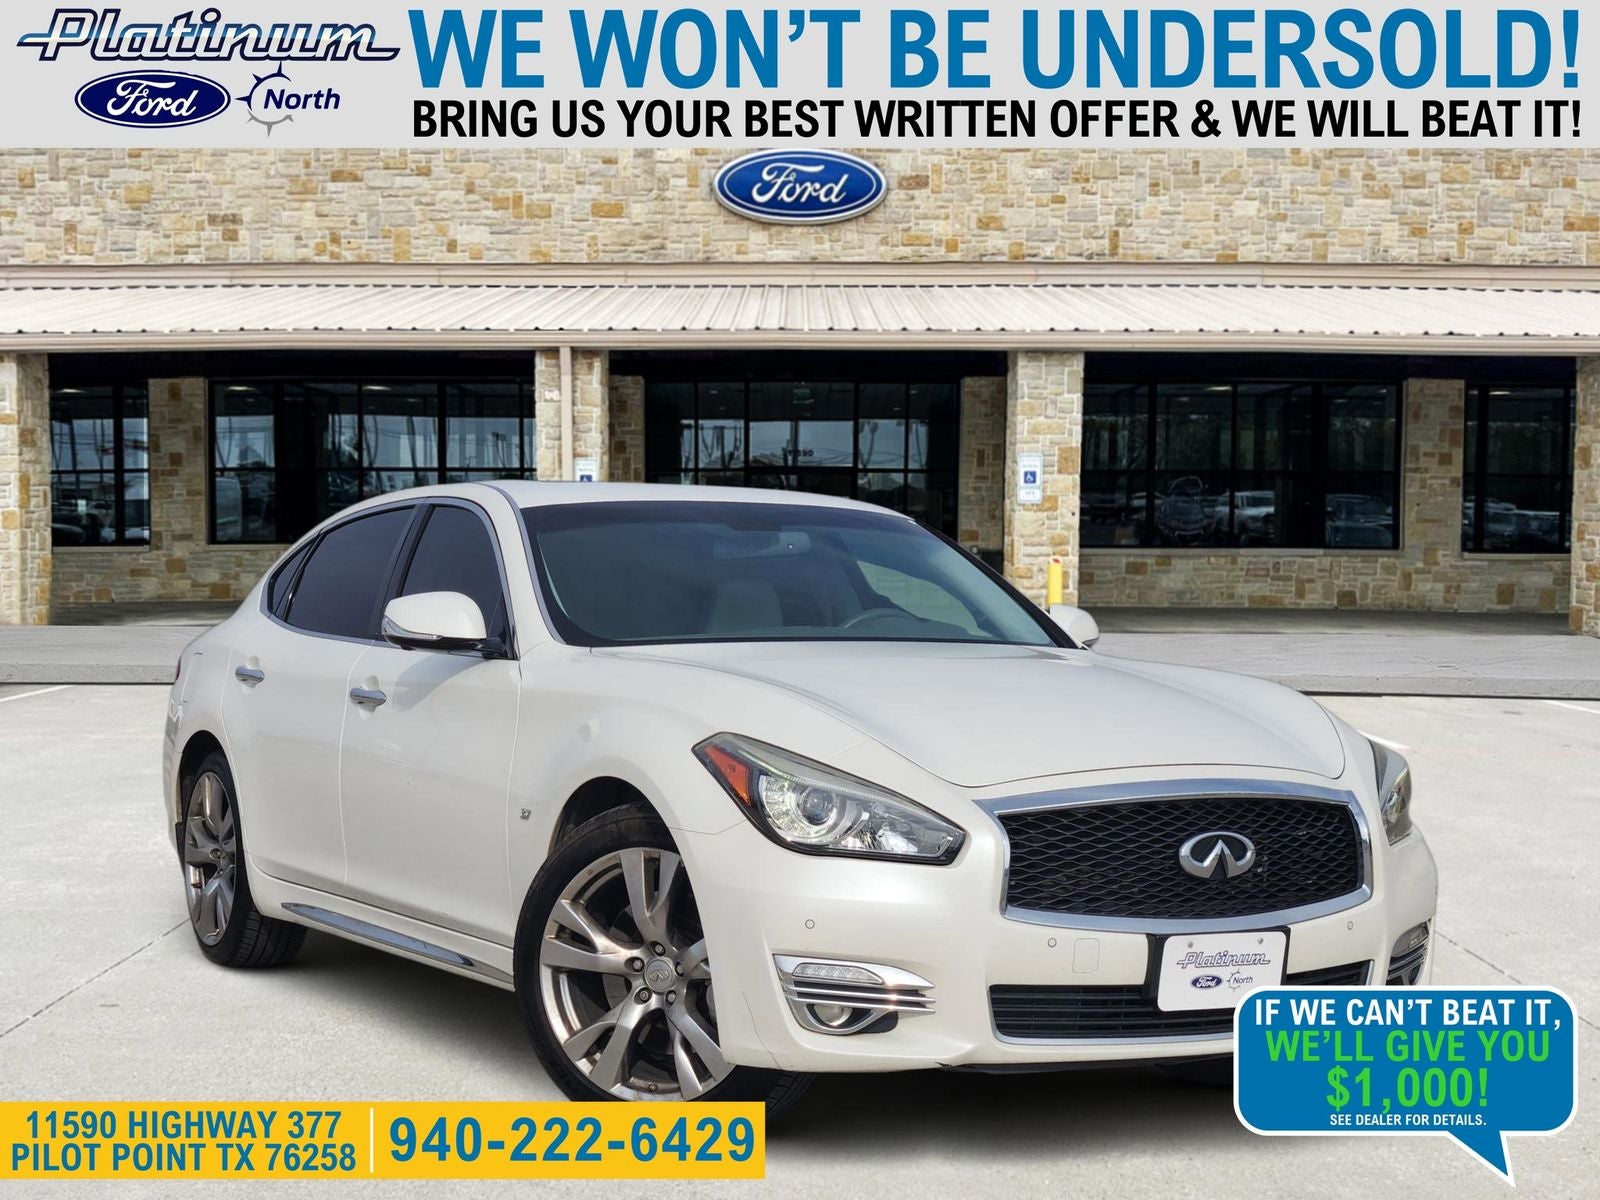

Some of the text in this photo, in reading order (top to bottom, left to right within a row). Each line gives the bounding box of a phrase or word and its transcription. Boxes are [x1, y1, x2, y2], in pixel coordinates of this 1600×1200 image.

[752, 162, 849, 203] Ford
[1176, 950, 1271, 969] Platinum
[1195, 975, 1218, 988] Ford
[1232, 975, 1254, 985] North
